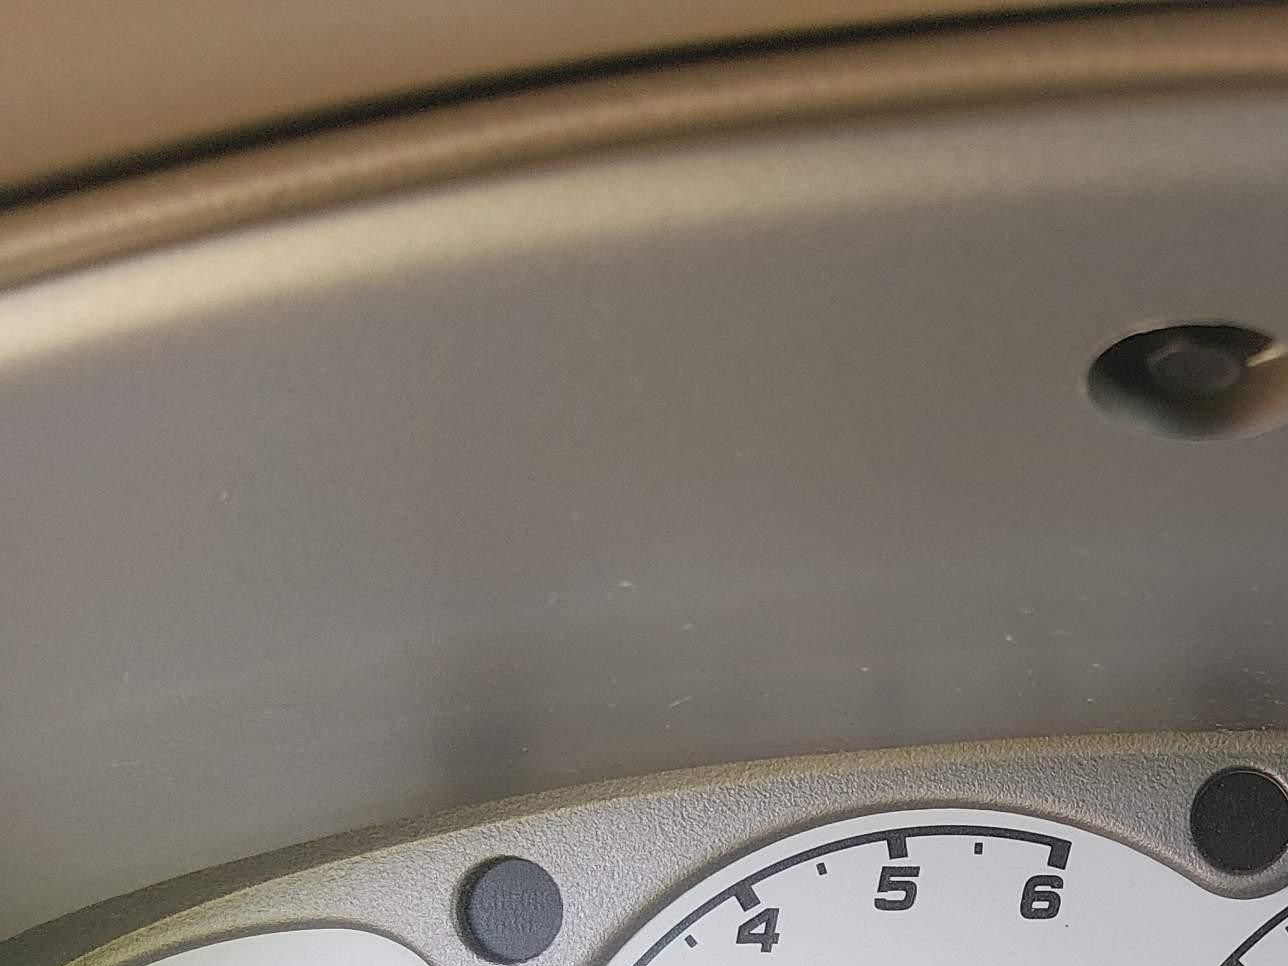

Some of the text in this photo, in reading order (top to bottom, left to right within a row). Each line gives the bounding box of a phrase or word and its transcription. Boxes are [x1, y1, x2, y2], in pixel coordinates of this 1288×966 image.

[874, 866, 920, 911] 5
[1020, 875, 1063, 919] 6
[734, 908, 780, 953] 4
